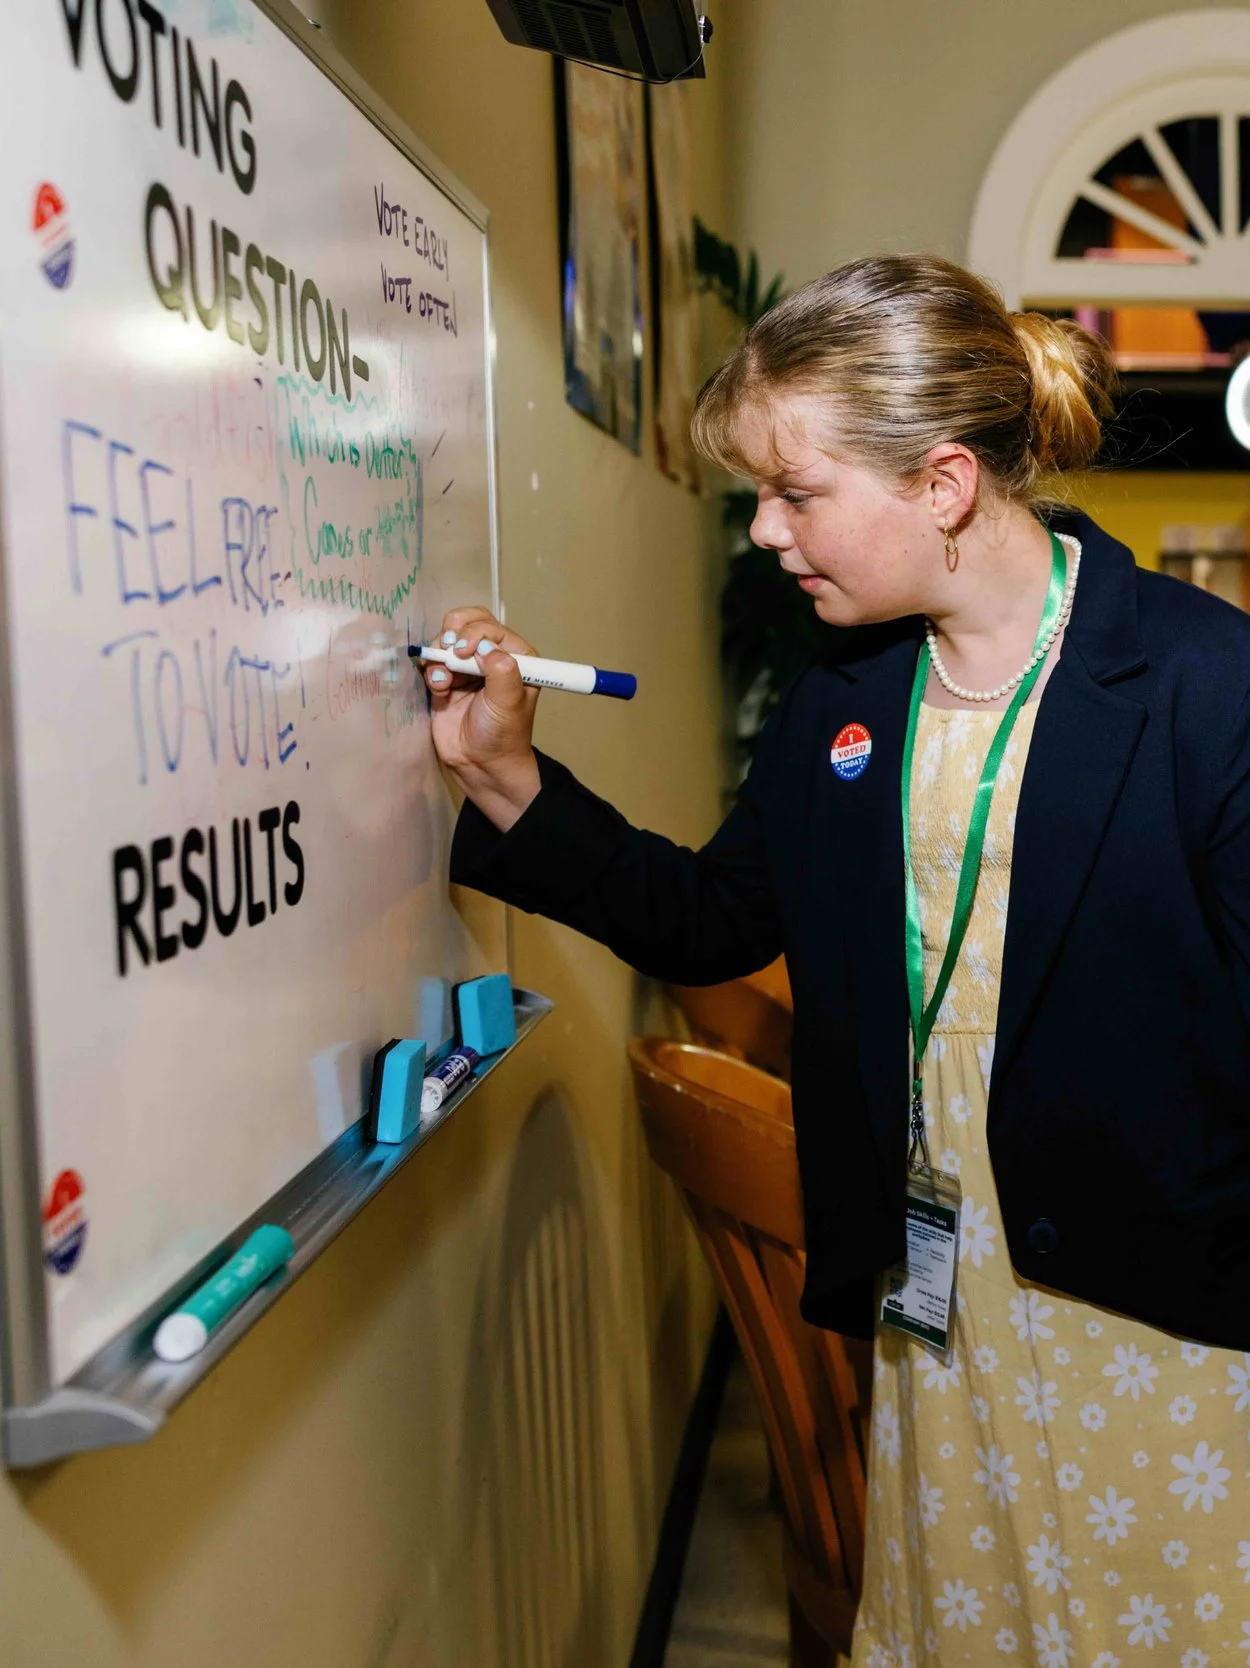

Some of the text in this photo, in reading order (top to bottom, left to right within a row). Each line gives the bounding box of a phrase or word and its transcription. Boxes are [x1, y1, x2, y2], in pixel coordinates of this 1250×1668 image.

[58, 0, 256, 195] VOTING
[374, 182, 449, 282] VOTE EARLY
[380, 262, 458, 338] VOTE OFTEN
[64, 418, 222, 606] FEEL
[102, 629, 184, 786] TO
[837, 745, 866, 759] VOTED
[849, 733, 854, 744] I
[840, 757, 863, 770] TODAY
[113, 800, 305, 978] RESULTS
